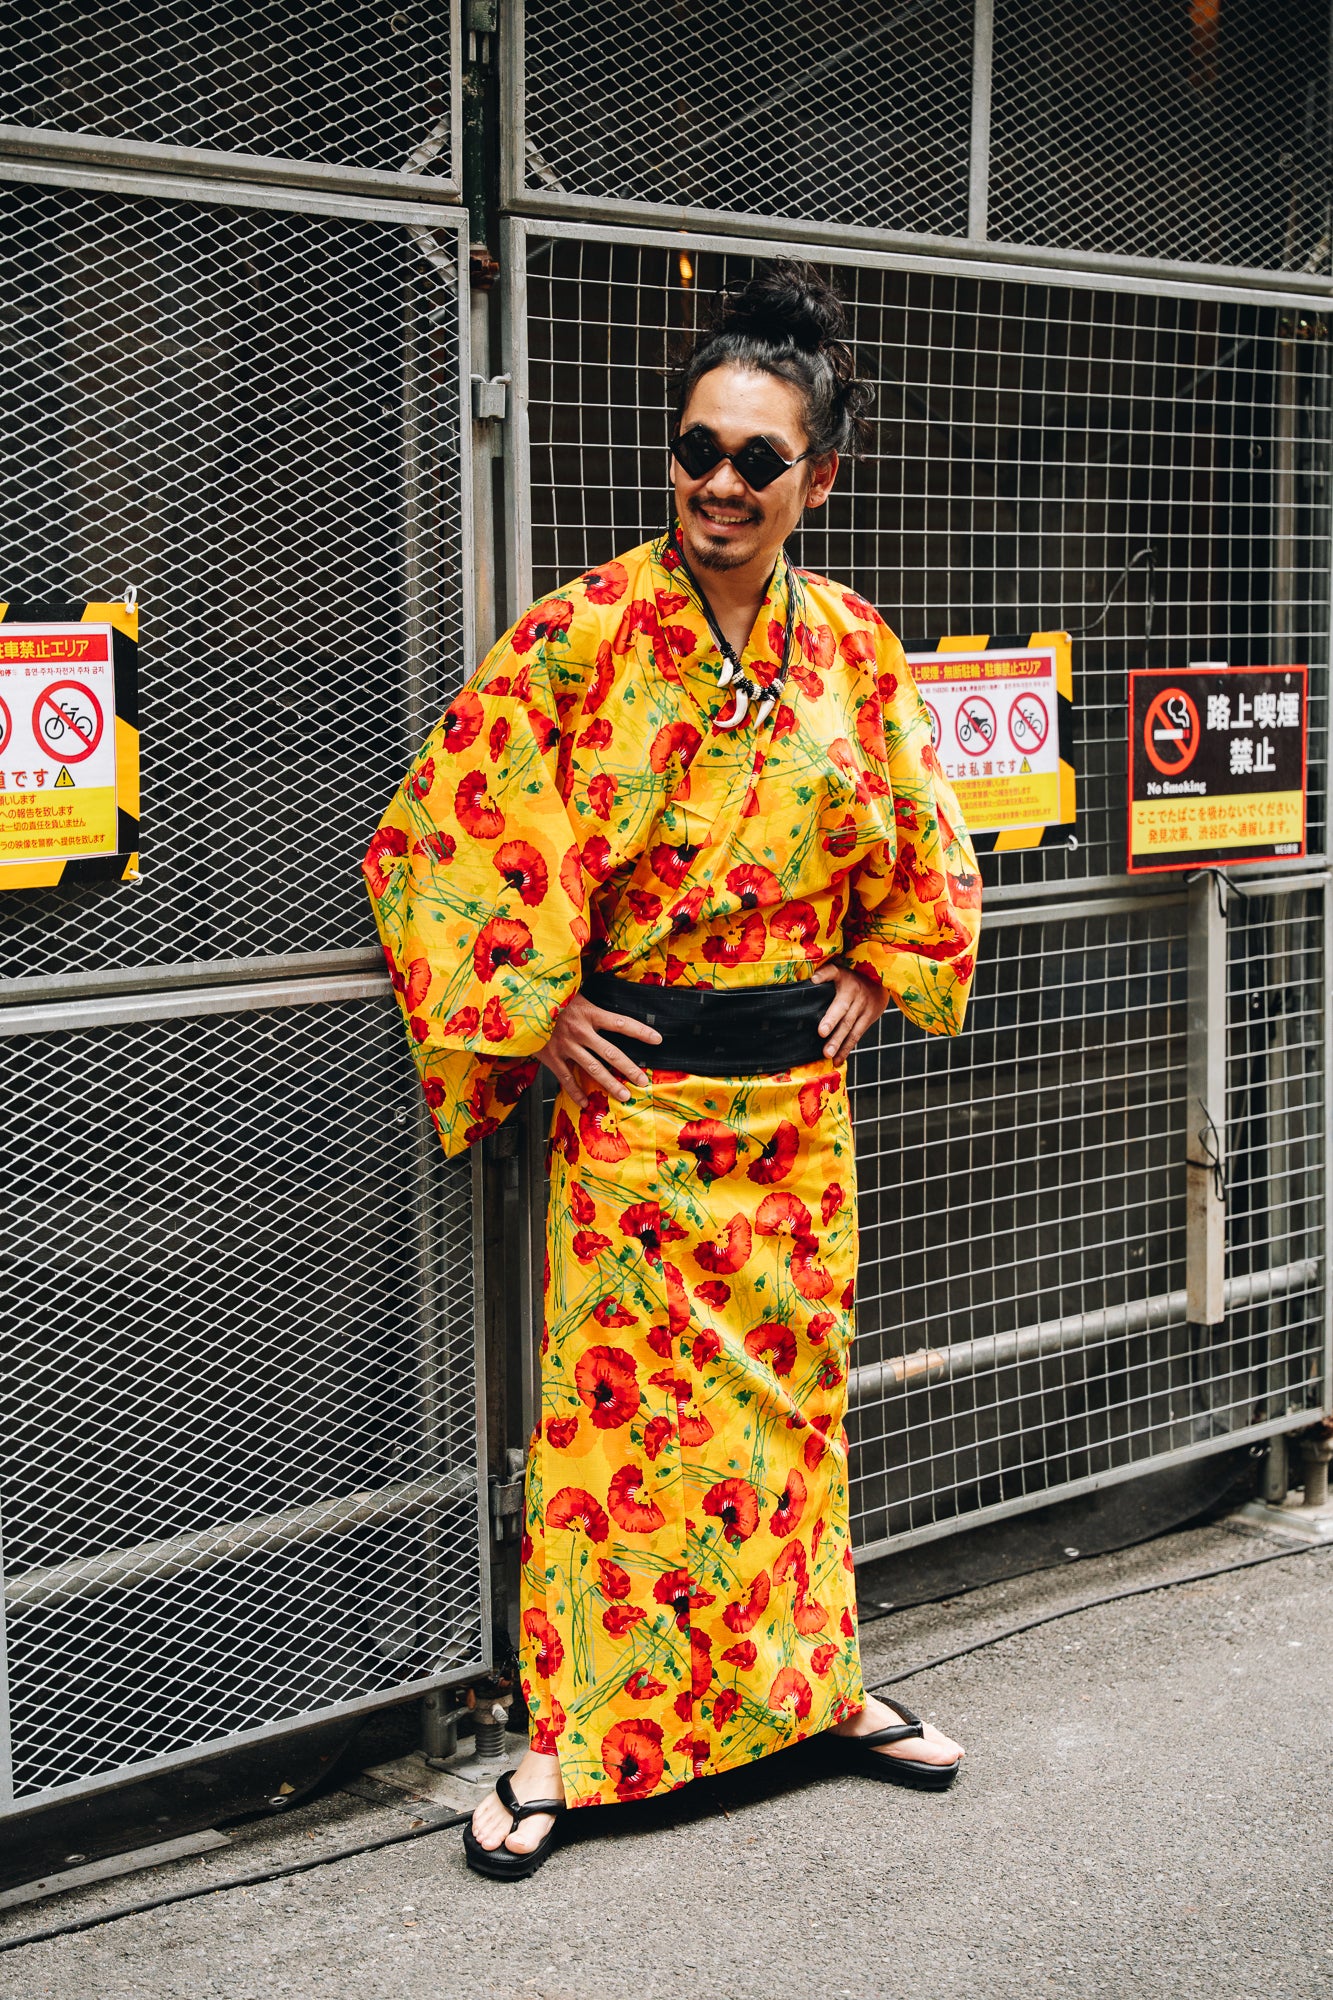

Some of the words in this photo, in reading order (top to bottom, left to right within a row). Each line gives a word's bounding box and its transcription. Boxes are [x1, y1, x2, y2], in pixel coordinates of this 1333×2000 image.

[910, 660, 1042, 681] 上喫煙・無断駐輪・駐車禁止エリア
[1206, 692, 1300, 731] 路上喫煙
[1229, 736, 1277, 775] 禁止
[1147, 782, 1162, 795] No
[1163, 780, 1207, 795] Smoking
[1137, 802, 1299, 825] ここでたばこを吸わないでください。
